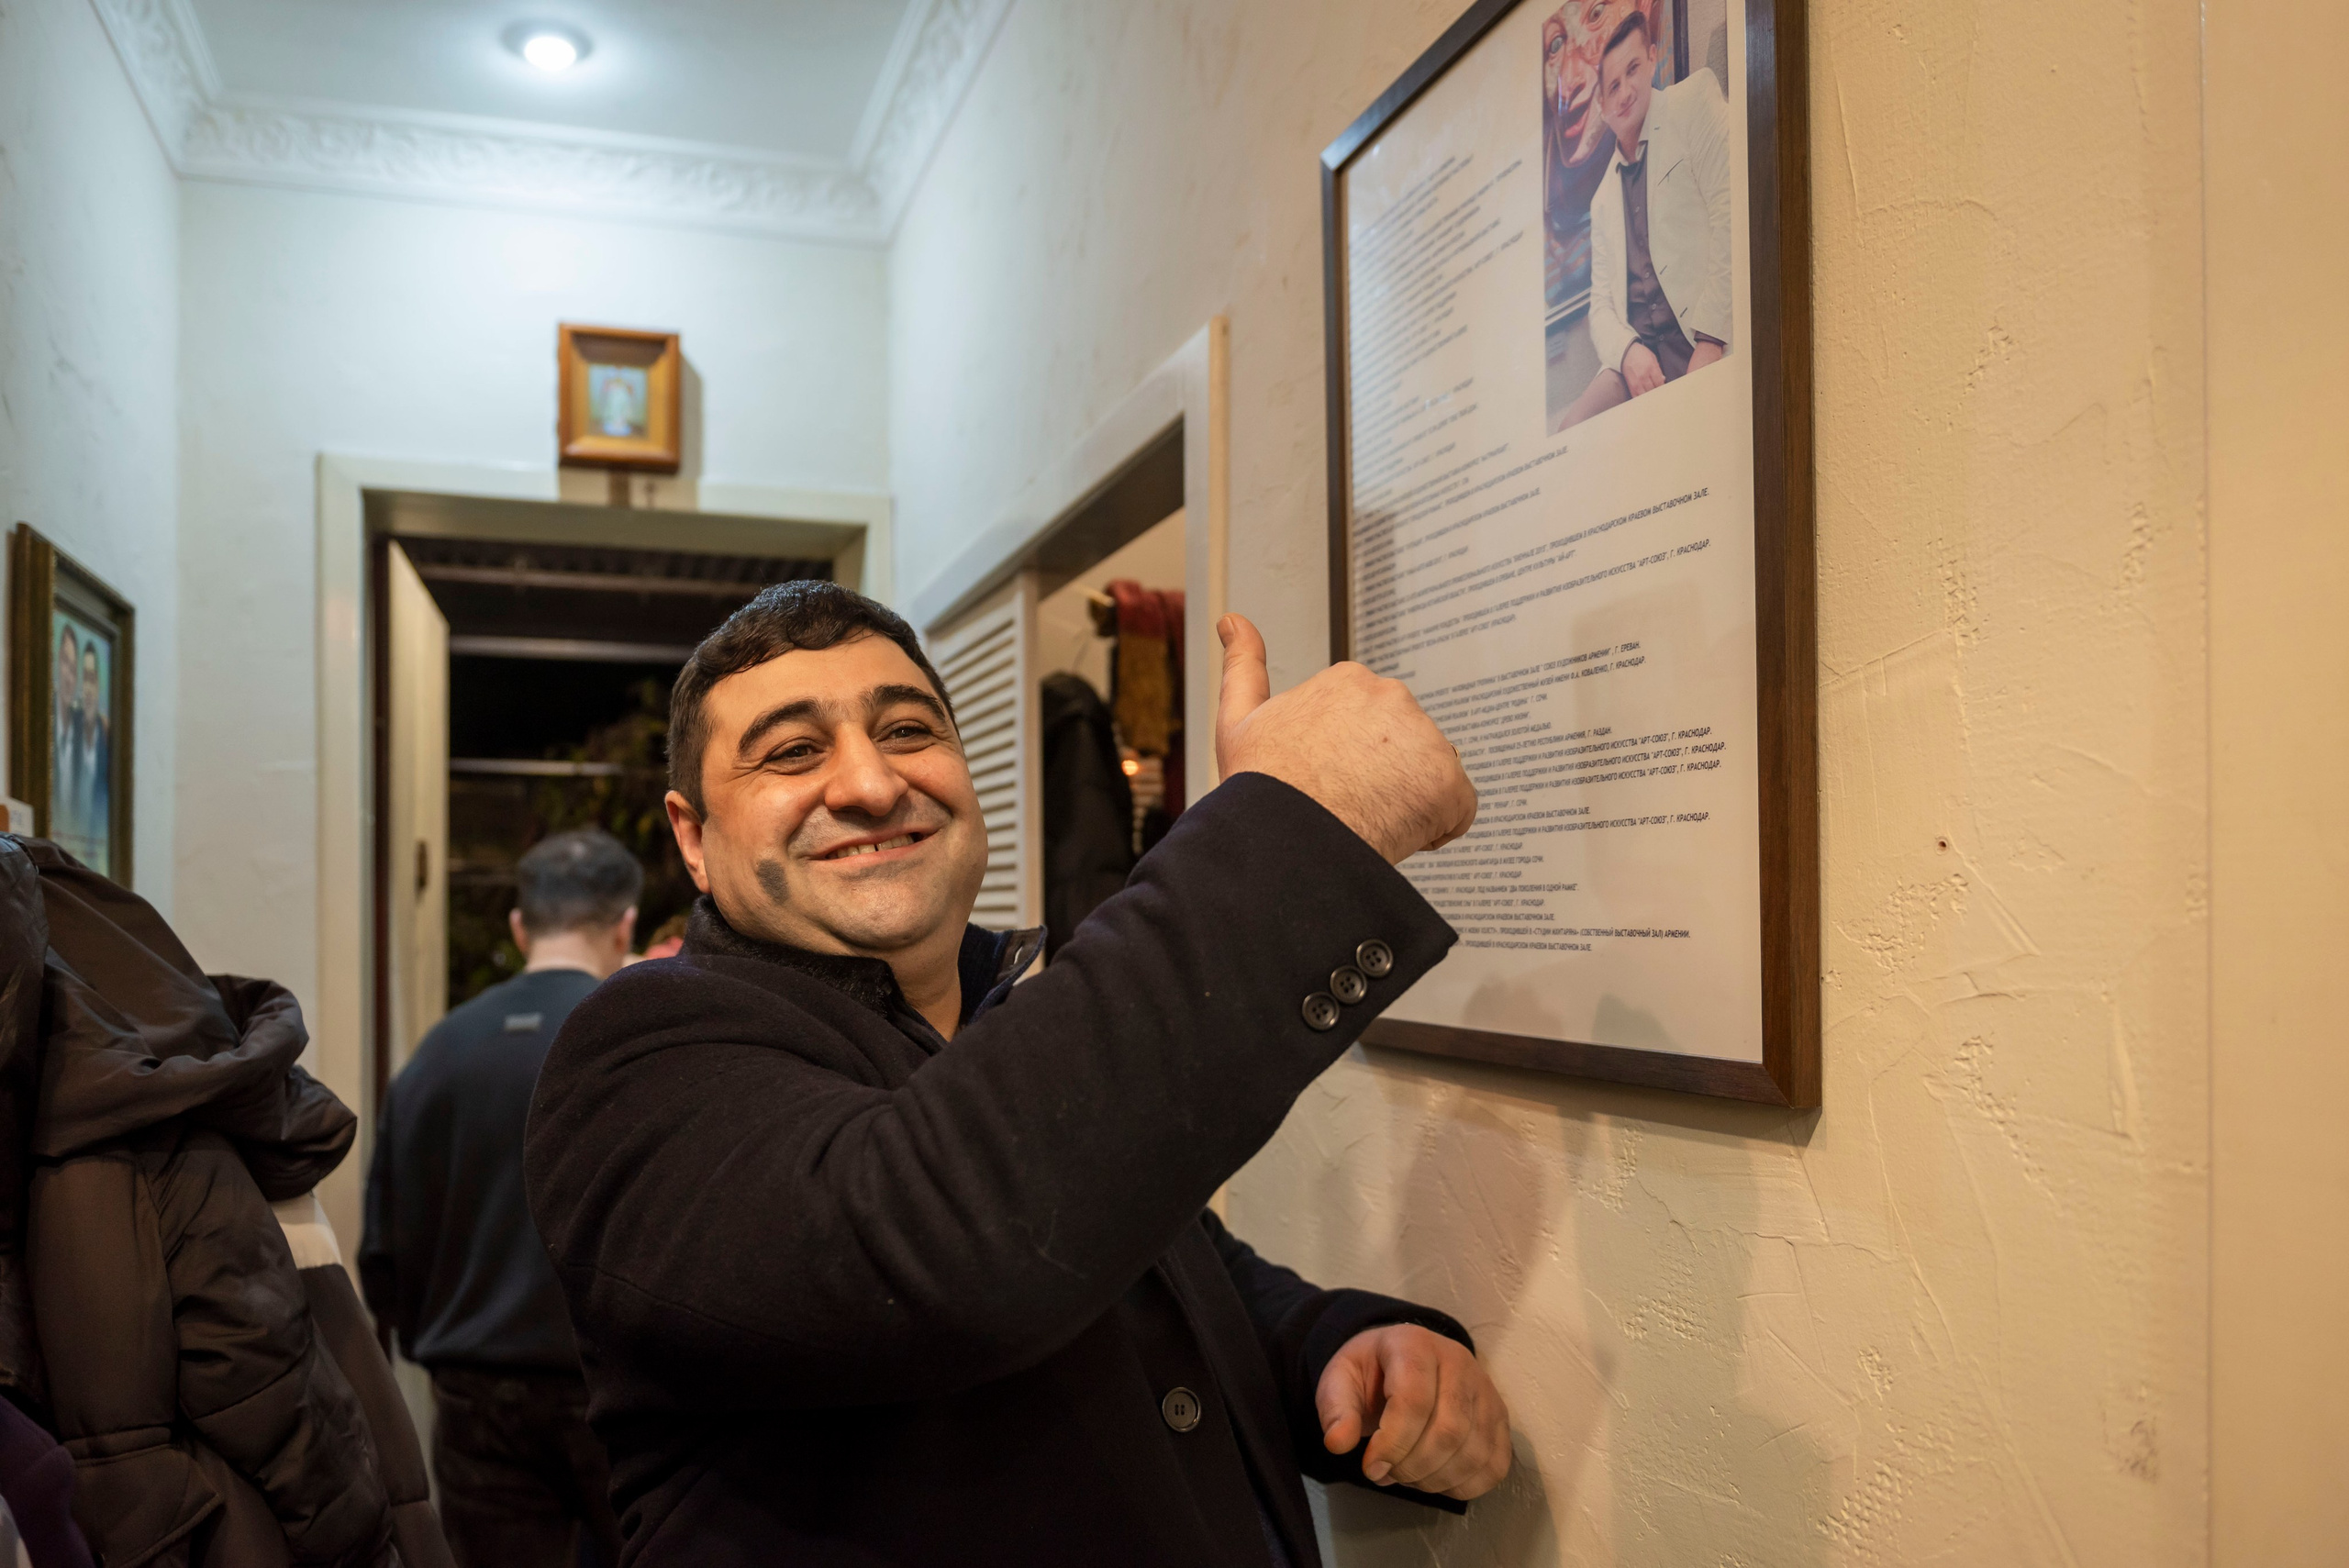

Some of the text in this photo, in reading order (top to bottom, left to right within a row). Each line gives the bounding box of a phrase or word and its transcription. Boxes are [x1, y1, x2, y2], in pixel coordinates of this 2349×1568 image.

[1628, 507, 1651, 522] КРАЕВОМ
[1653, 494, 1692, 514] ВЫСТАВОЧНОМ
[1693, 487, 1709, 500] ЗАЛЕ.
[1608, 562, 1636, 576] ИСКУССТВА
[1670, 550, 1675, 558] Г.
[1676, 539, 1710, 556] КРАСНОДАР.
[1620, 641, 1641, 652] ЕРЕВАН.
[1581, 664, 1609, 677] КОВАЛЕНКО,
[1616, 656, 1646, 670] КРАСНОДАР.
[1564, 743, 1609, 757] ИЗОБРАЗИТЕЛЬНОГО
[1610, 739, 1637, 750] ИСКУССТВА
[1671, 732, 1676, 740] Г.
[1678, 727, 1711, 740] КРАСНОДАР.
[1593, 727, 1612, 737] РАЗДАН.
[1575, 757, 1620, 770] ИЗОБРАЗИТЕЛЬНОГО
[1622, 752, 1650, 763] ИСКУССТВА
[1691, 742, 1726, 754] КРАСНОДАР.
[1571, 773, 1617, 785] ИЗОБРАЗИТЕЛЬНОГО
[1619, 770, 1645, 780] ИСКУССТВА
[1680, 764, 1685, 773] Г.
[1687, 760, 1721, 772] КРАСНОДАР.
[1564, 820, 1609, 831] ИЗОБРАЗИТЕЛЬНОГО
[1609, 818, 1636, 828] ИСКУССТВА
[1670, 815, 1675, 823] Г.
[1676, 812, 1709, 823] КРАСНОДАР.
[1615, 929, 1650, 938] ВЫСТАВОЧНЫЙ
